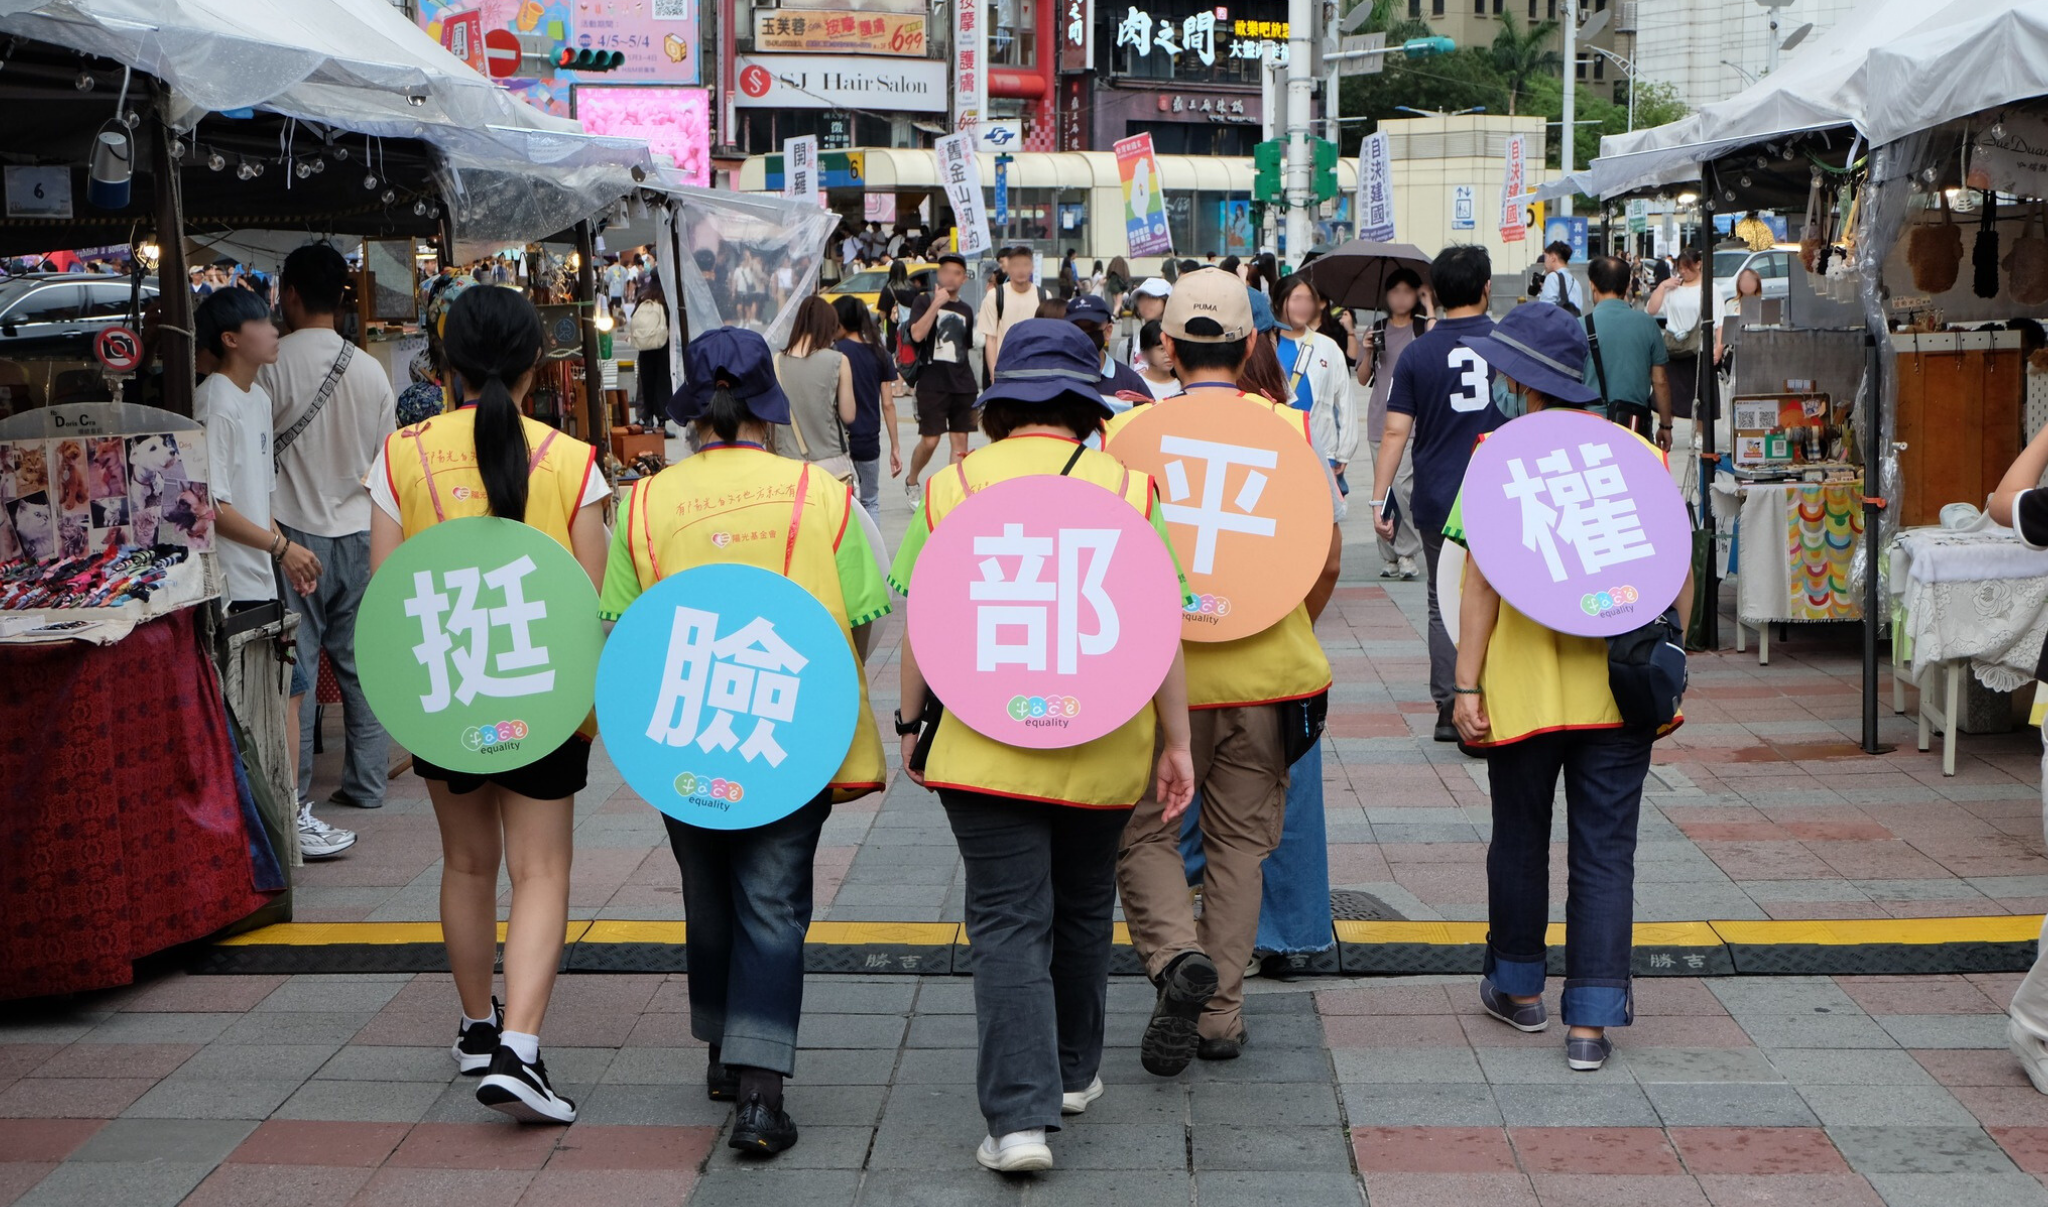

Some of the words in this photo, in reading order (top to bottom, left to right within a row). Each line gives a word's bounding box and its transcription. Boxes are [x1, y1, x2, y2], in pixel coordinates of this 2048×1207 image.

[762, 17, 805, 36] 玉芙蓉
[1116, 6, 1216, 66] 肉之間
[780, 72, 807, 90] SJ
[823, 73, 874, 91] Hair
[877, 74, 928, 94] Salon
[959, 50, 975, 93] 護膚
[793, 142, 807, 195] 開羅
[849, 160, 859, 179] 6
[1370, 138, 1384, 226] 自決建國
[1506, 140, 1520, 225] 自決建國
[34, 182, 45, 199] 6
[946, 139, 979, 250] 舊金山和約
[1193, 303, 1218, 312] PUMA
[1447, 347, 1490, 413] 3
[55, 415, 78, 428] Doris
[79, 414, 96, 426] Cra
[1160, 435, 1278, 575] 平
[1502, 442, 1656, 583] 權
[732, 530, 777, 543] 陽光基金會
[970, 523, 1122, 674] 部
[1600, 605, 1634, 618] equality
[403, 554, 556, 713] 挺
[645, 605, 809, 768] 臉
[1025, 718, 1069, 728] equality
[480, 742, 521, 755] equality
[689, 796, 731, 812] equality
[1650, 953, 1706, 968] 勝吉
